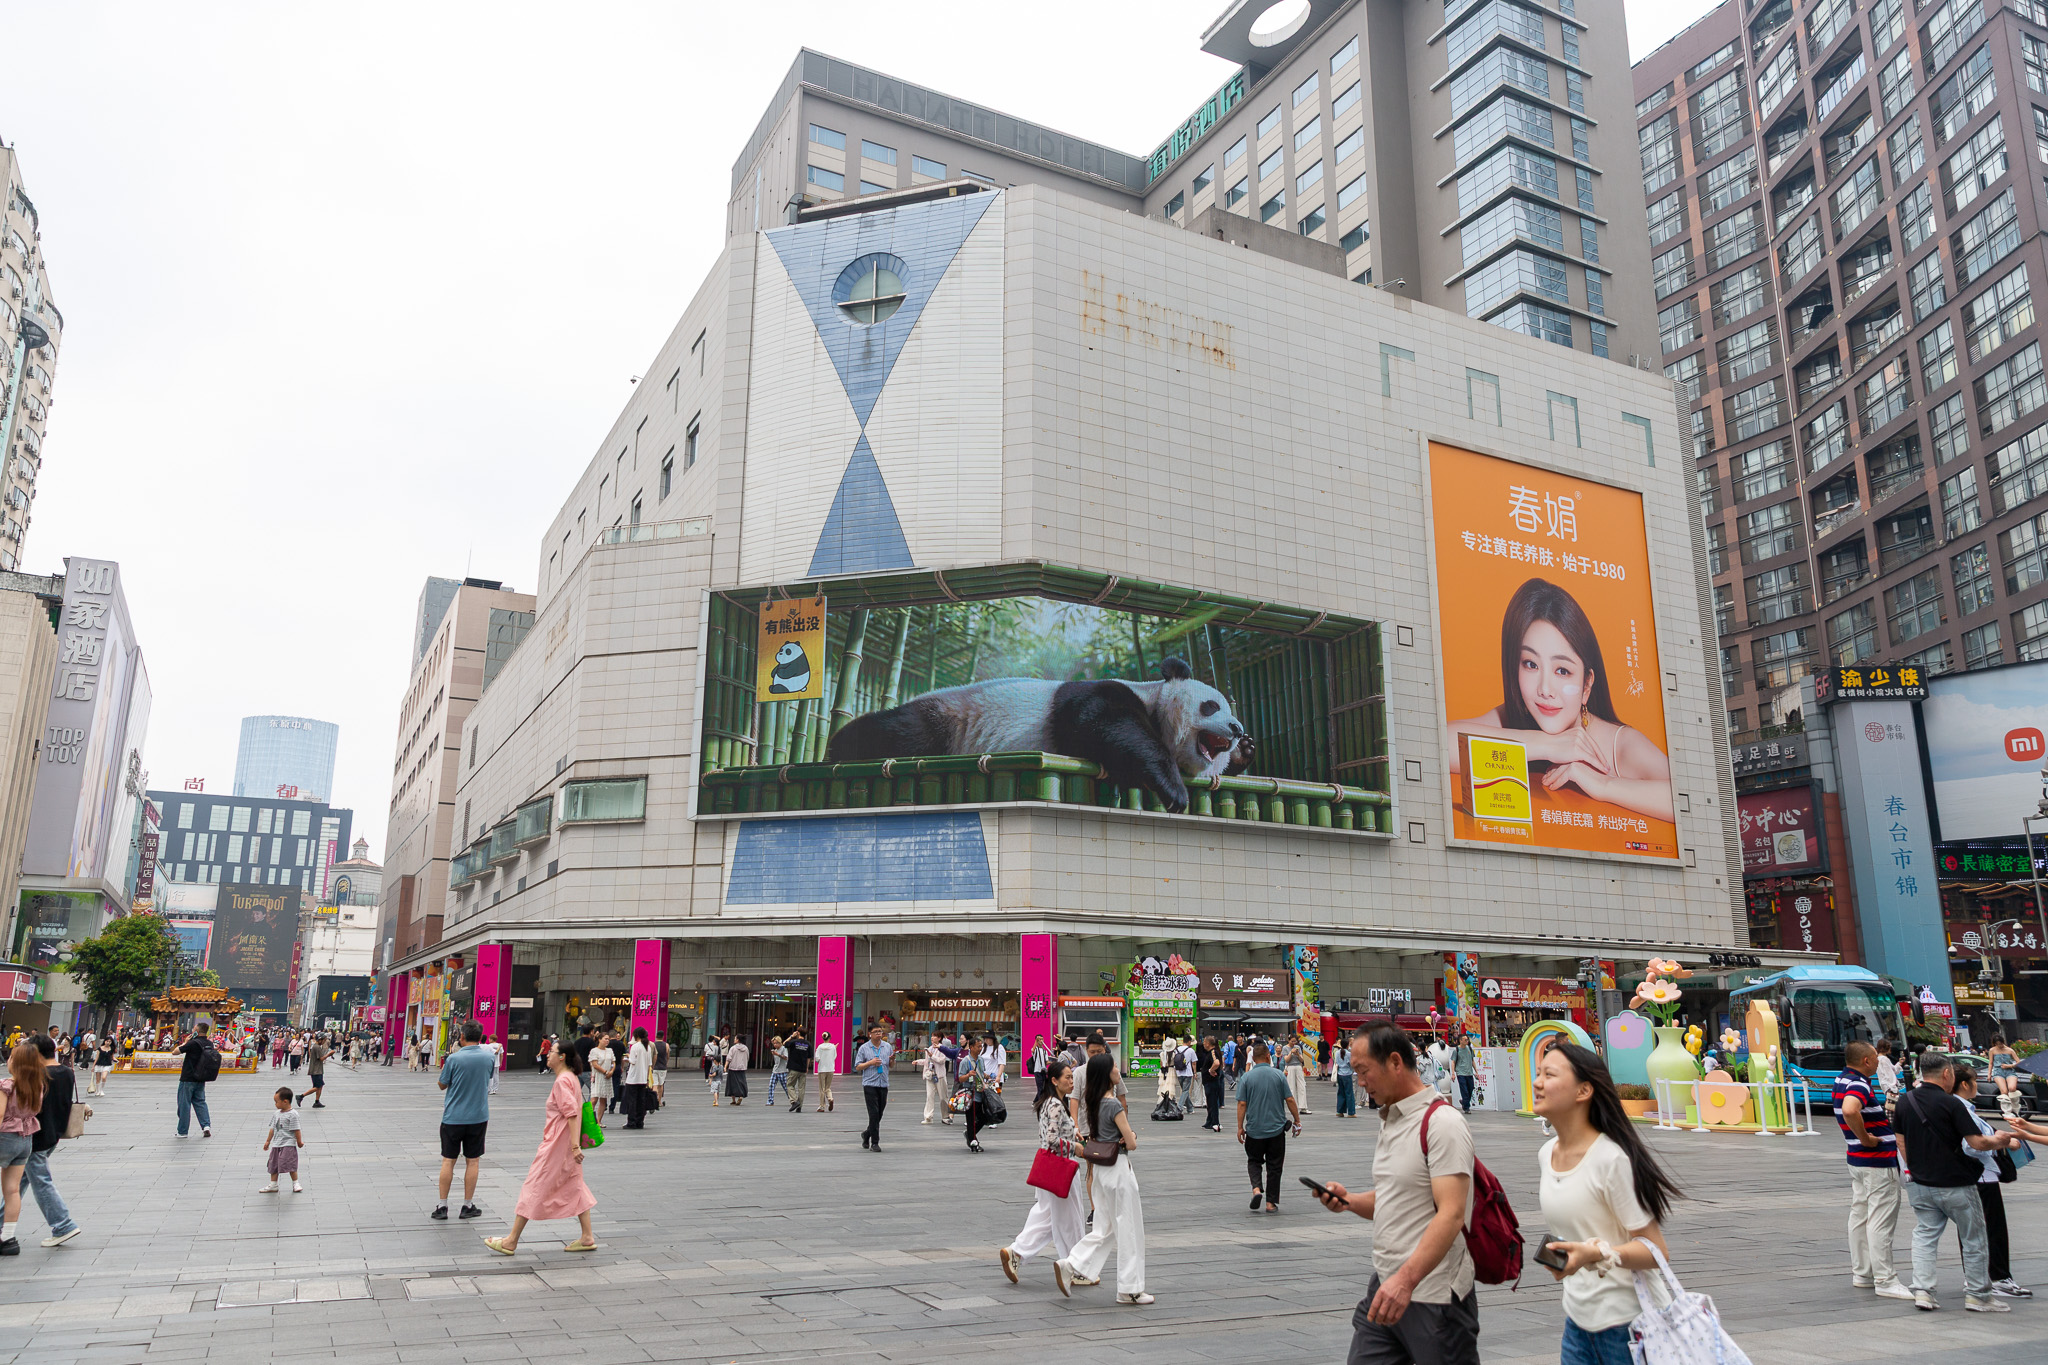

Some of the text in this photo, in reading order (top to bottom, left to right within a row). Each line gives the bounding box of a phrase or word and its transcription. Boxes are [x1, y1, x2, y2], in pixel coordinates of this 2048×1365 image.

[1148, 71, 1244, 184] 海悦酒店
[1508, 485, 1578, 543] 春娟
[1460, 530, 1626, 581] 专注黄芪养肤·始于1980
[55, 561, 114, 702] 如家酒店
[765, 616, 820, 635] 有熊出没
[1815, 674, 1830, 698] 6F
[1906, 687, 1919, 696] 6F
[50, 726, 85, 746] TOP
[46, 744, 82, 764] TOY
[1491, 749, 1508, 762] 春娟
[1784, 746, 1795, 755] 6F
[1540, 808, 1649, 834] 春娟黄芪霜 养出好气色
[1883, 795, 1919, 898] 春台市锦
[1958, 854, 2032, 873] 長藤密室
[35, 926, 68, 936] LULU
[1142, 974, 1190, 991] 熊猫冰粉
[1249, 974, 1276, 987] gelato
[479, 1002, 491, 1011] BF
[639, 1000, 651, 1010] BF
[824, 1000, 837, 1010] BF
[930, 999, 991, 1007] NOISY TEDDY
[1030, 1000, 1044, 1011] BF
